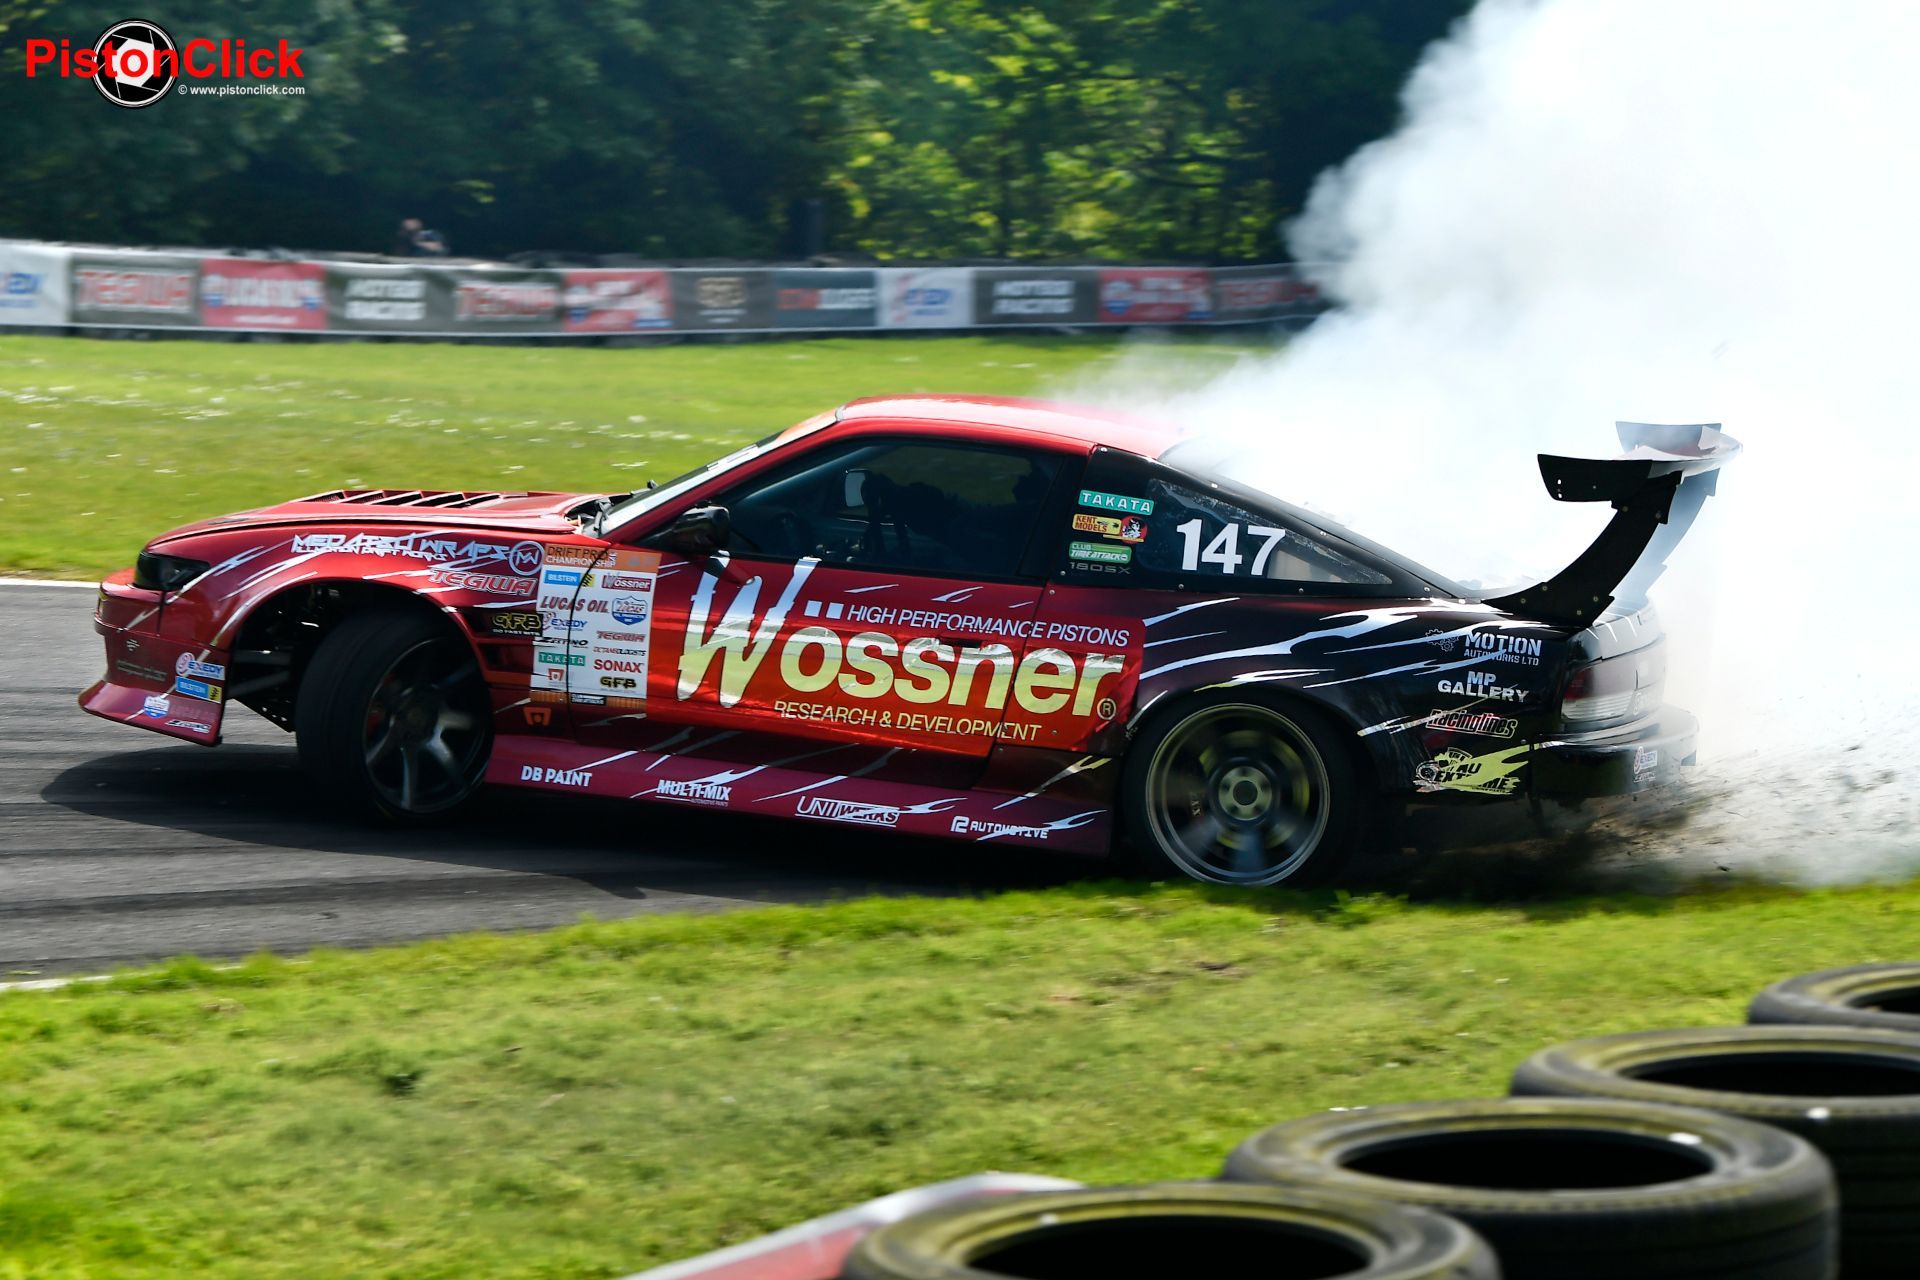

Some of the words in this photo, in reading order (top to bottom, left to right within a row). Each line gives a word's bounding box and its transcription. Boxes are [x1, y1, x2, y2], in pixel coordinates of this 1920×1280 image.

[1082, 492, 1151, 513] TAKATA
[1075, 522, 1108, 532] MODELS
[1077, 515, 1098, 525] KENT
[419, 539, 512, 564] WRAPS
[548, 547, 582, 559] DRIFT
[1176, 518, 1287, 576] 147
[1069, 562, 1131, 575] 180SX
[428, 566, 540, 597] TEGIWA
[541, 595, 586, 612] LUCAS
[587, 599, 609, 614] OIL
[551, 618, 588, 628] EXEDY
[847, 604, 897, 625] HIGH
[898, 609, 1047, 639] PERFORMANCE
[1047, 622, 1130, 647] PISTONS
[1464, 631, 1542, 657] MOTION
[593, 658, 643, 674] SONAX
[1521, 656, 1540, 666] LTD
[1467, 670, 1497, 686] MP
[1437, 679, 1530, 703] GALLERY
[774, 700, 878, 727] RESEARCH
[879, 710, 892, 728] &
[896, 712, 1043, 742] DEVELOPMENT
[521, 765, 543, 781] DB
[545, 768, 593, 787] PAINT
[656, 779, 733, 801] MULTI-MIX
[970, 820, 1050, 840] AUTOMOTIVE
